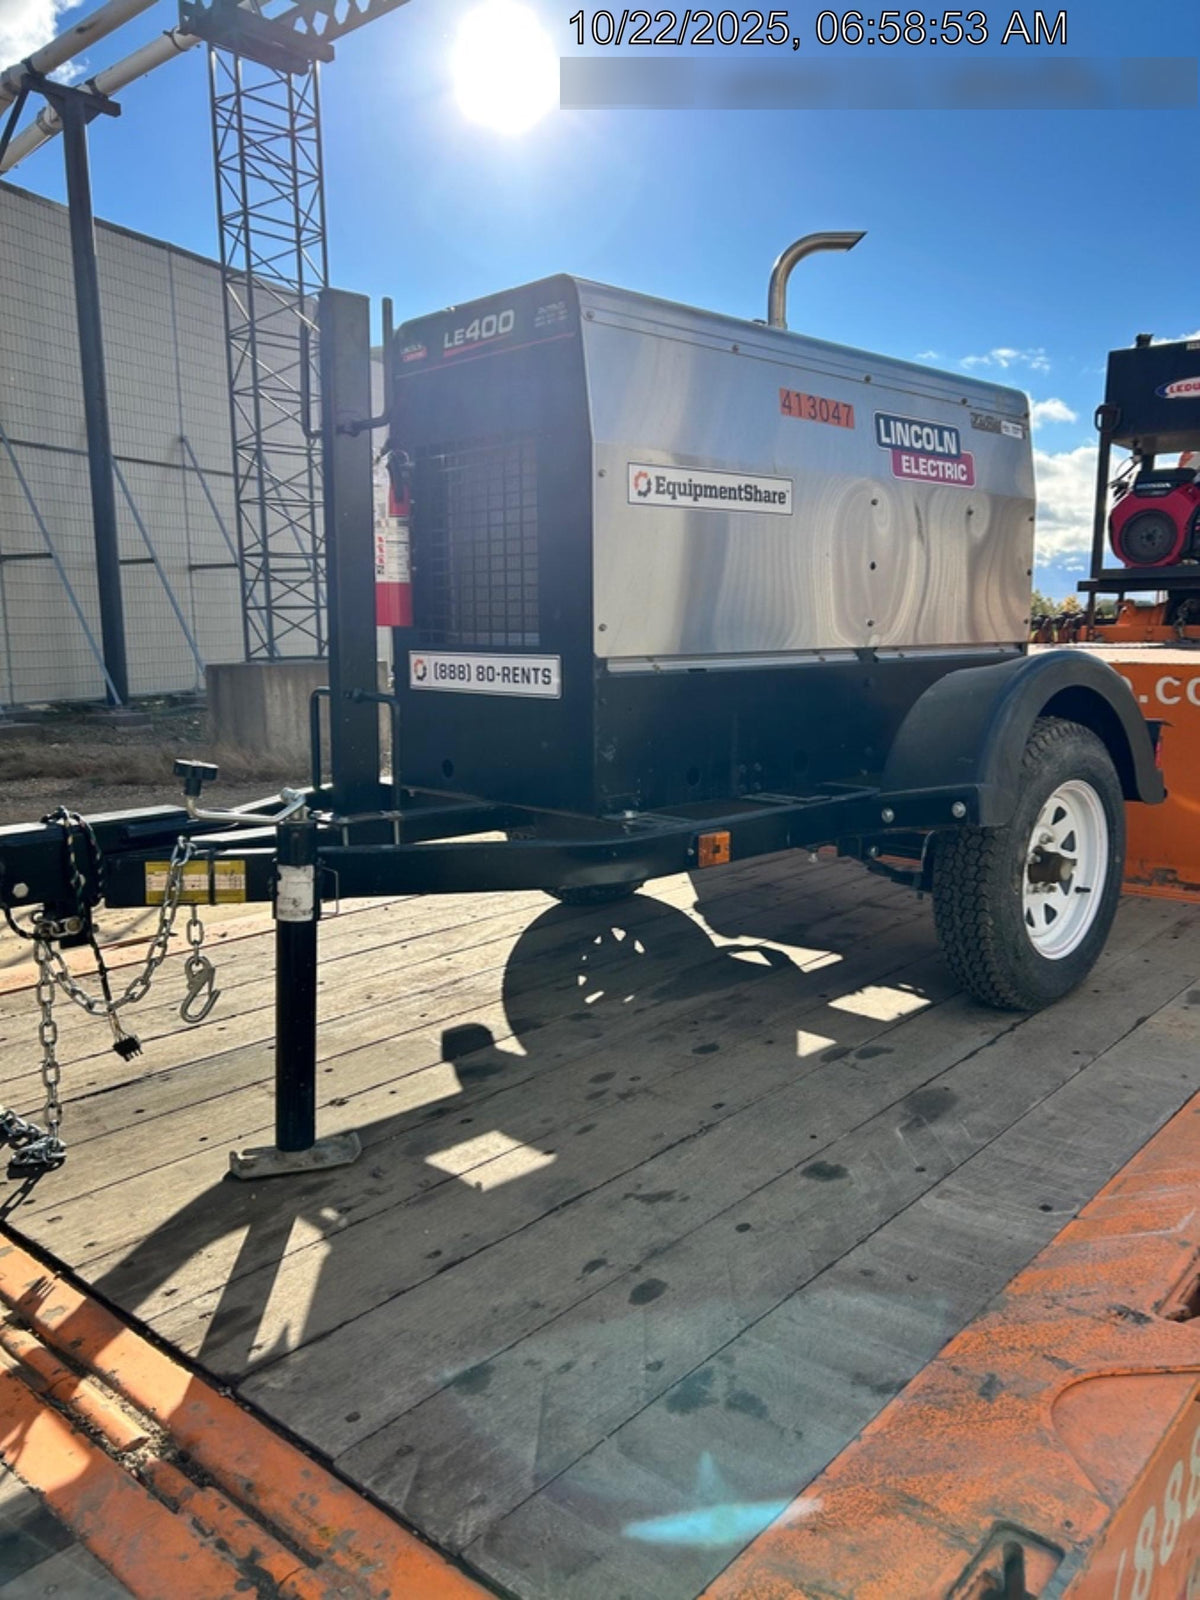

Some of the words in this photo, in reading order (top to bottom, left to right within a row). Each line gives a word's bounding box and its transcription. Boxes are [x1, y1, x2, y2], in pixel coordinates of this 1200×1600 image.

[443, 308, 515, 348] LE400
[781, 390, 852, 427] 413047
[880, 418, 957, 455] LINCOLN
[901, 454, 968, 481] ELECTRIC
[654, 475, 787, 504] EquipmentShare
[433, 662, 471, 682] (888)
